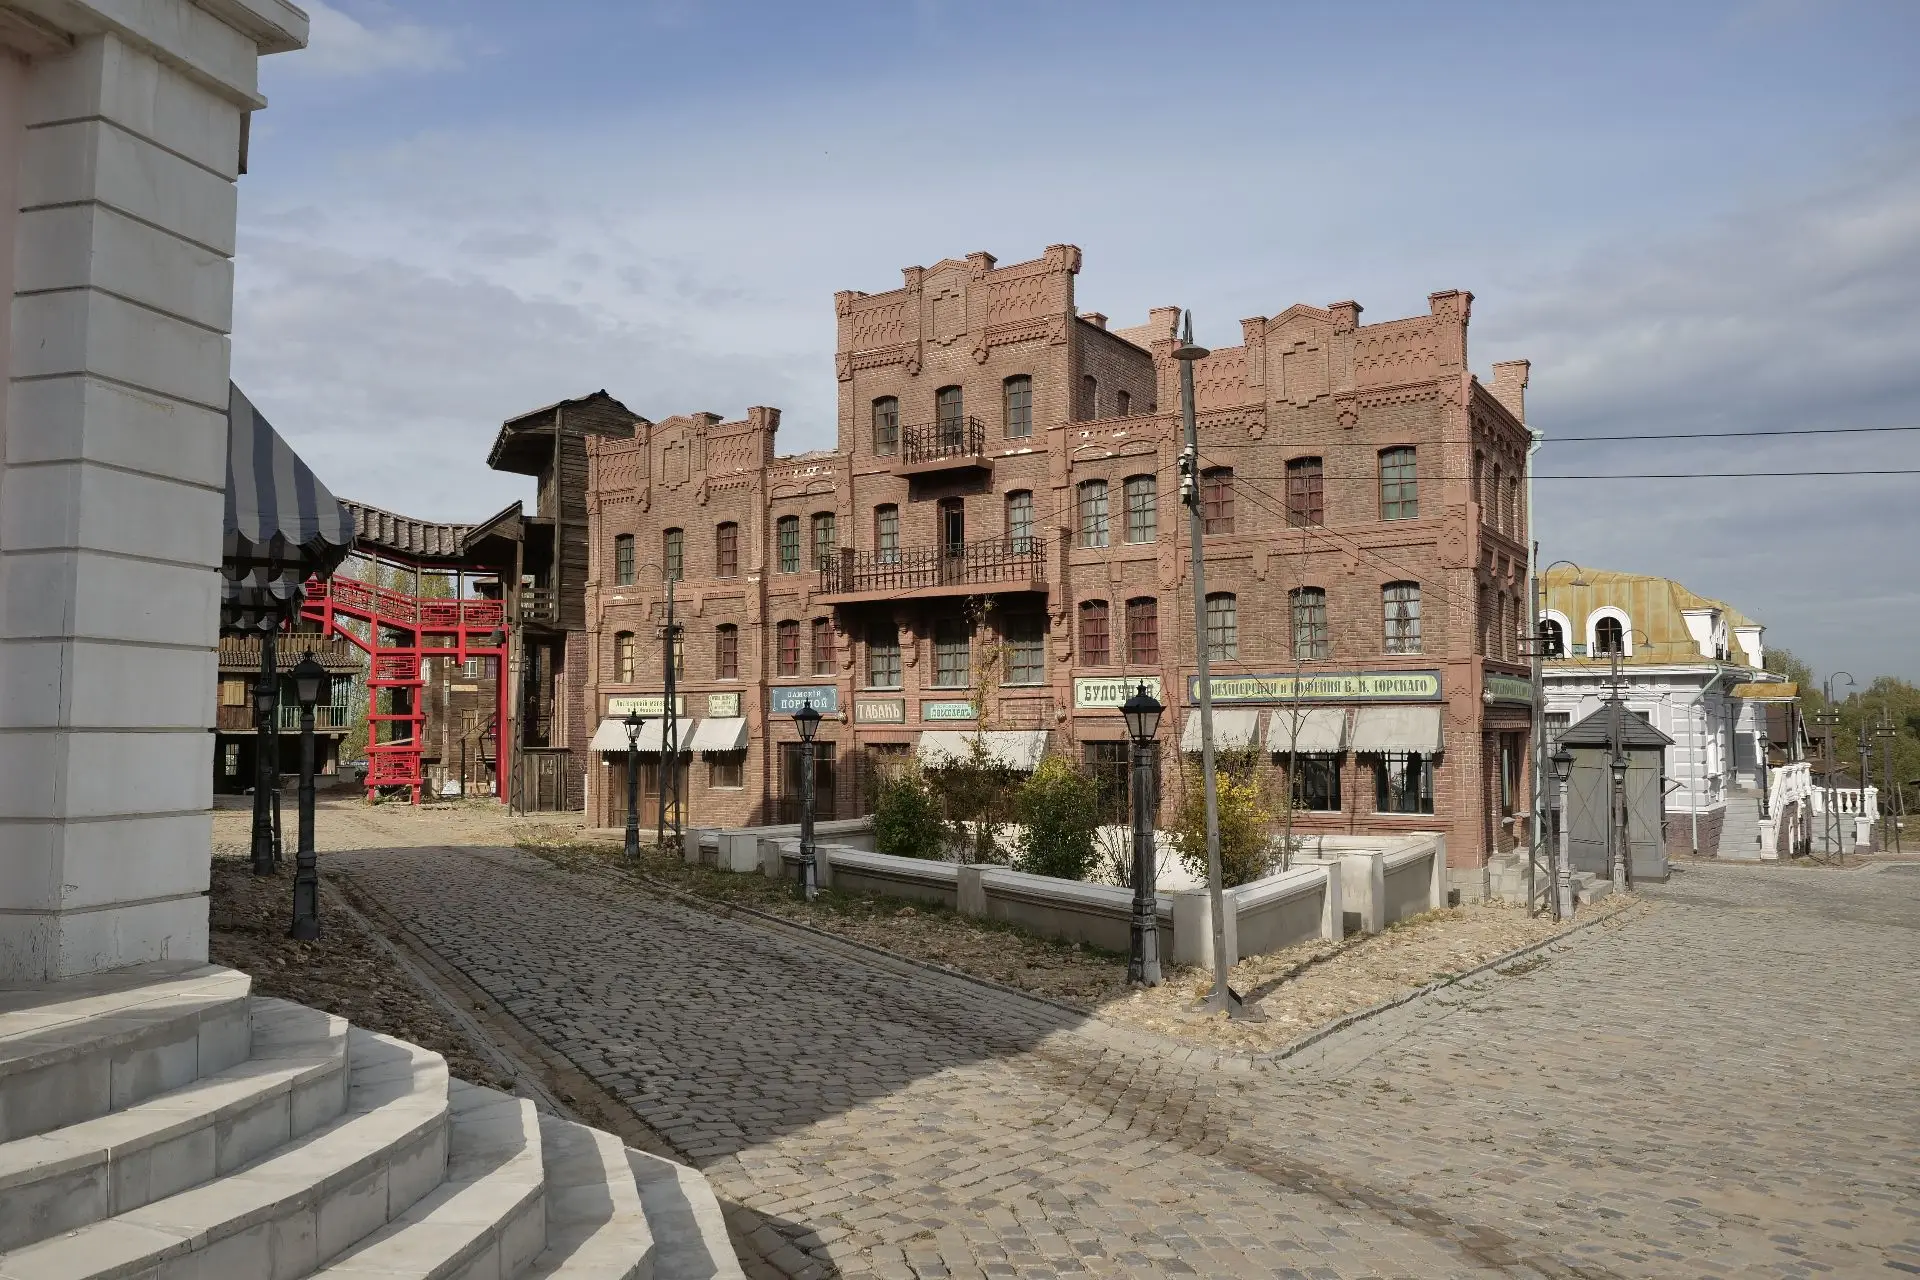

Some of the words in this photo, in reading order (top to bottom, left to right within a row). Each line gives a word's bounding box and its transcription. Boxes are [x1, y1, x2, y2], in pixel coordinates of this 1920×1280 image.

[1084, 684, 1154, 702] БУЛОЧНЯ
[1209, 682, 1277, 696] ОНДИТЕРСКАЯ
[1344, 680, 1355, 693] В.
[857, 703, 900, 719] ТАБАКЪ
